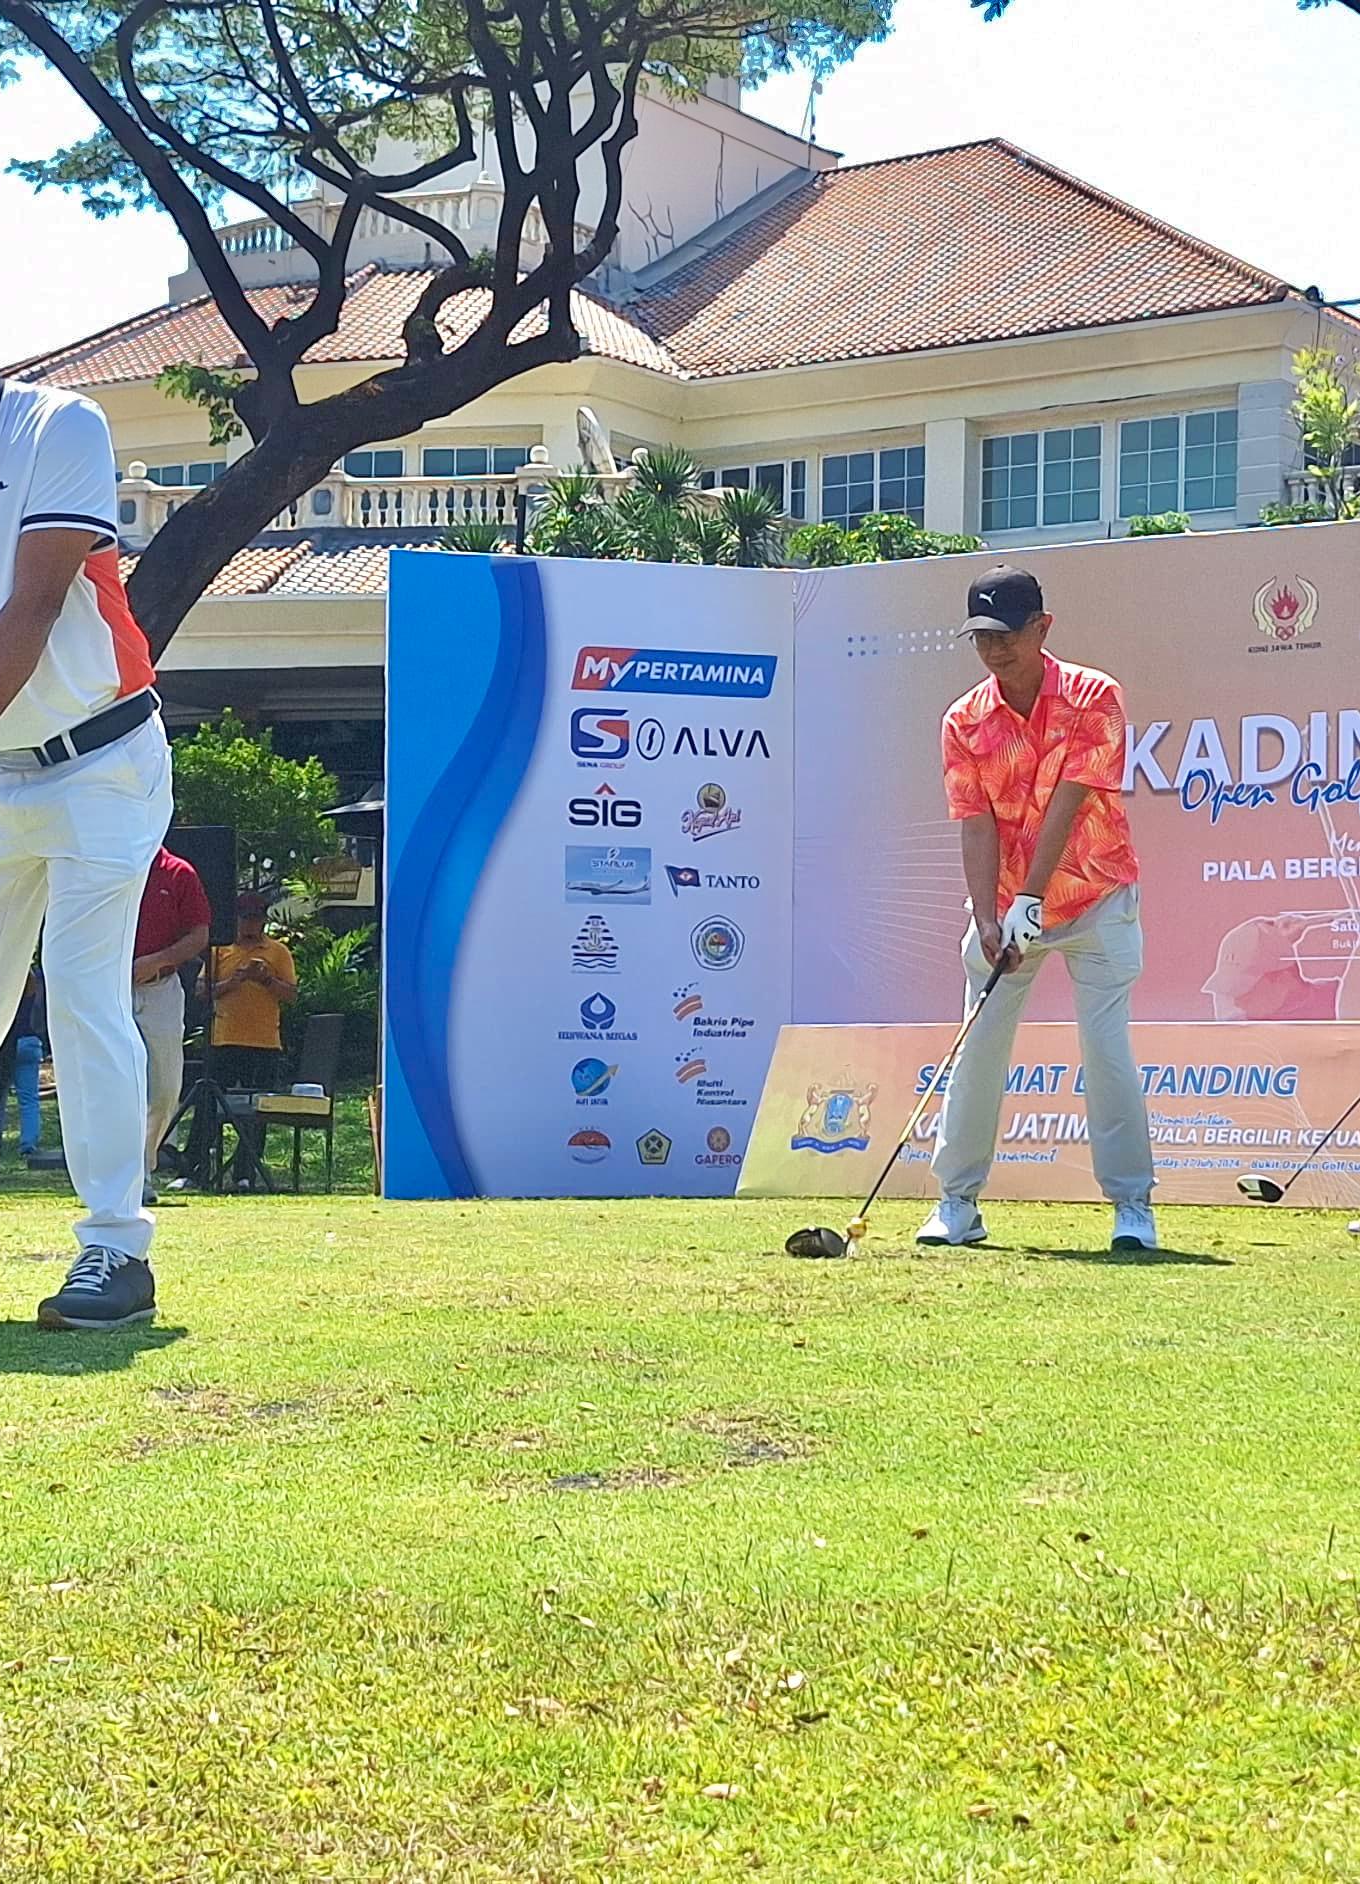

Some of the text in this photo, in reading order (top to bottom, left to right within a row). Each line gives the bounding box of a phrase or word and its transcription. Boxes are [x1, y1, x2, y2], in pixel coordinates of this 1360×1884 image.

[1181, 767, 1275, 825] Open
[568, 798, 642, 827] SIG
[1202, 859, 1277, 882] PIALA
[705, 874, 761, 889] TANTO
[693, 1017, 755, 1028] Bakrie Pipe
[693, 1028, 746, 1038] Industries
[915, 1064, 1068, 1094] SEMAT
[1003, 1112, 1090, 1140] JATIM
[1148, 1127, 1198, 1144] PIALA
[1203, 1127, 1291, 1146] BERGILIR
[694, 1154, 742, 1166] GAPERO
[1251, 1160, 1279, 1169] Bukit
[1321, 1161, 1345, 1171] Golf
